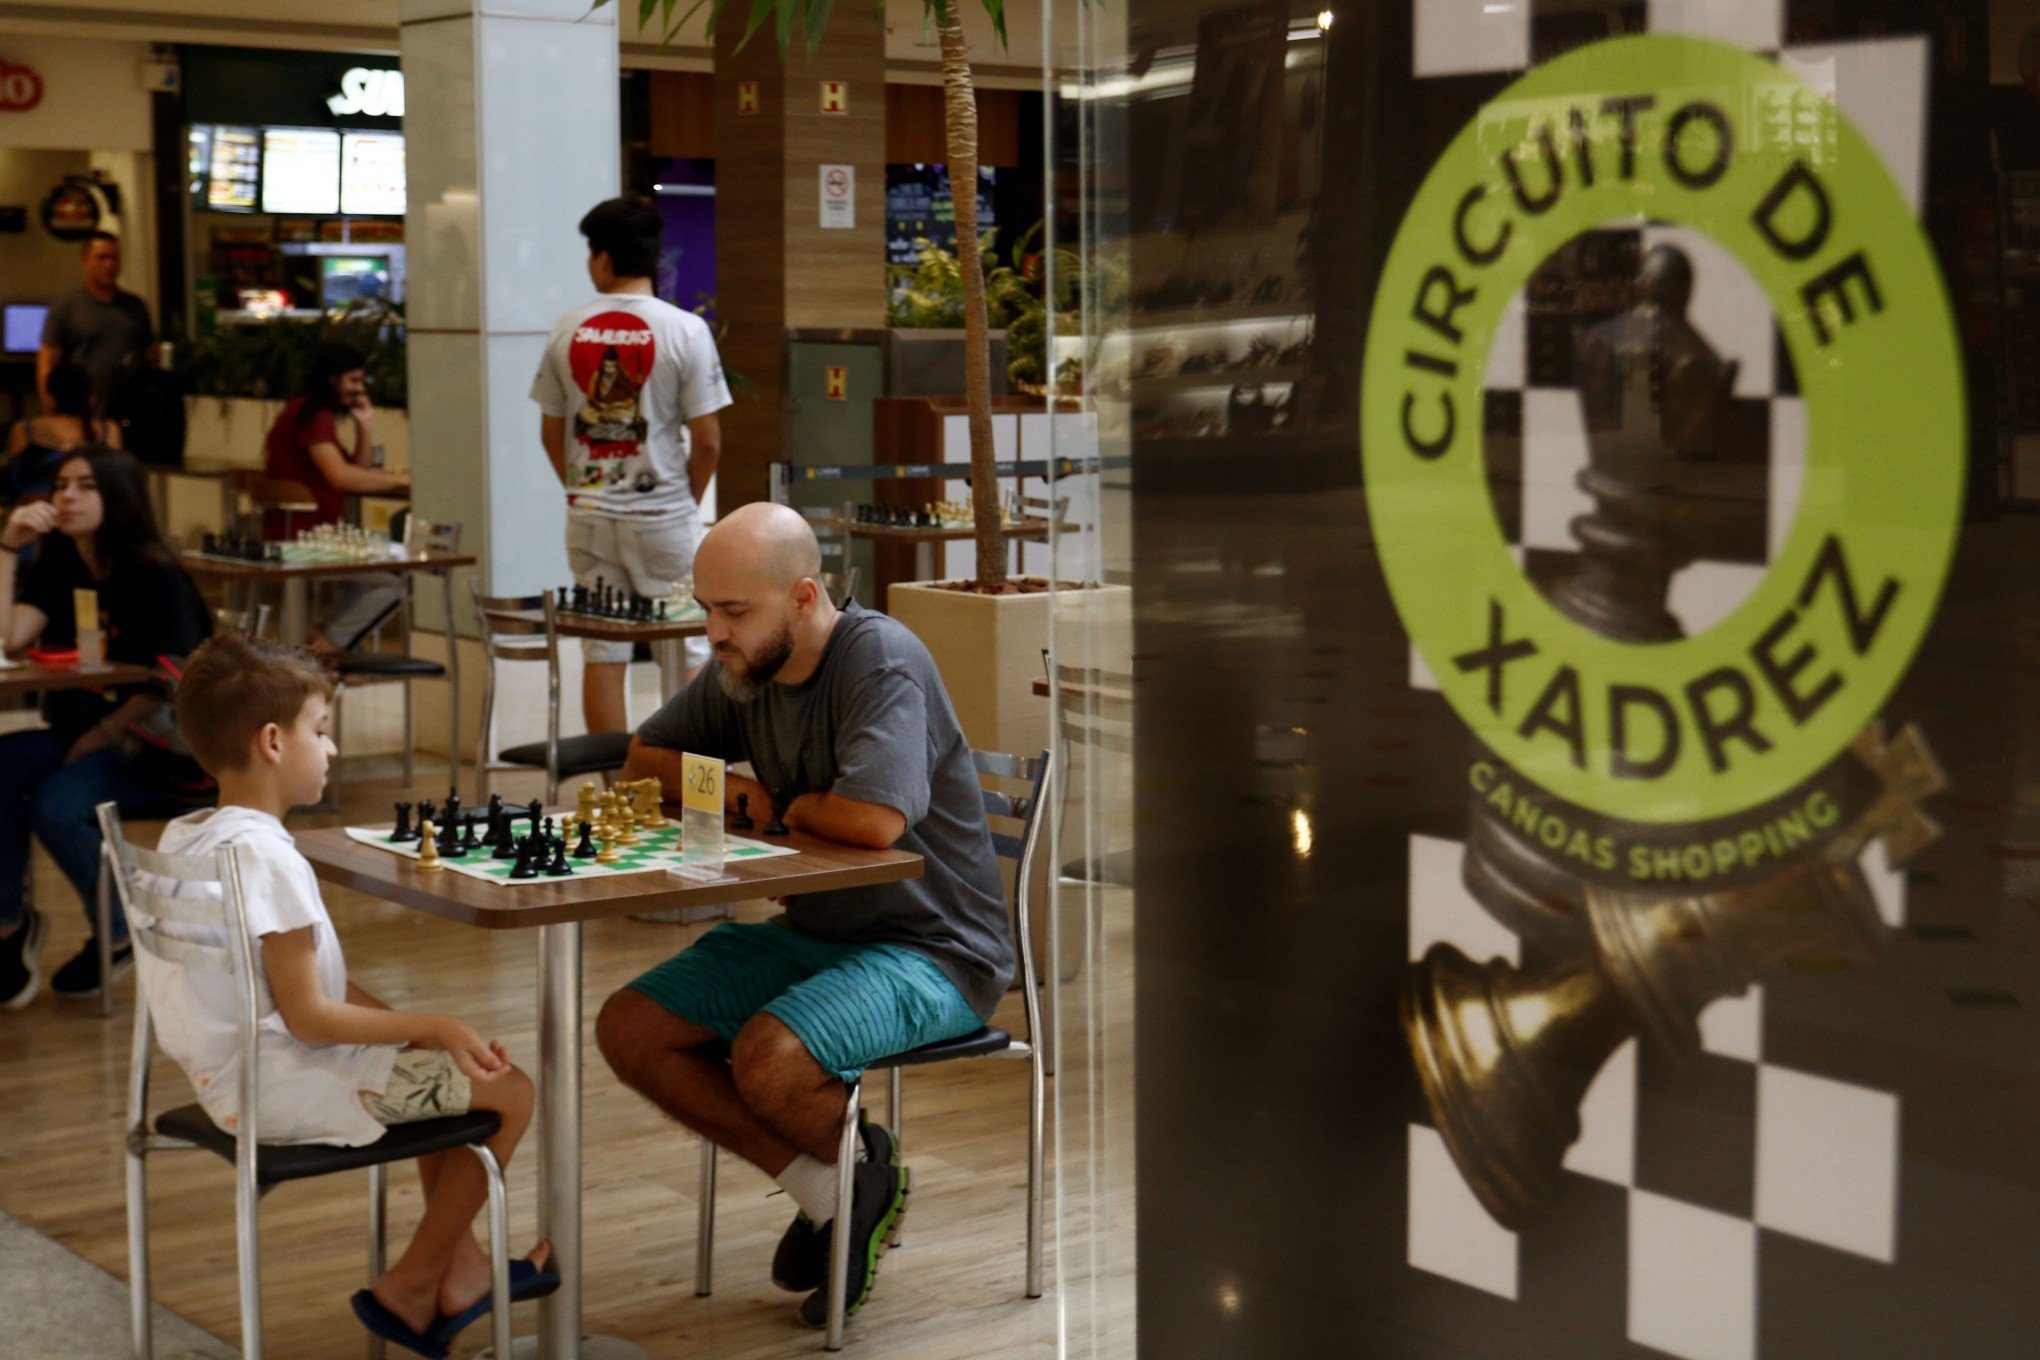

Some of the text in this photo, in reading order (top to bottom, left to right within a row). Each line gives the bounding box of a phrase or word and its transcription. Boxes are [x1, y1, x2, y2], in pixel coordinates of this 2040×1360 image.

[822, 83, 846, 112] H
[1402, 95, 1885, 459] CIRCUITO DE
[828, 367, 846, 397] H
[1451, 533, 1903, 780] XADREZ
[698, 765, 715, 795] 26
[1469, 760, 1839, 882] CANOAS SHOPPING
